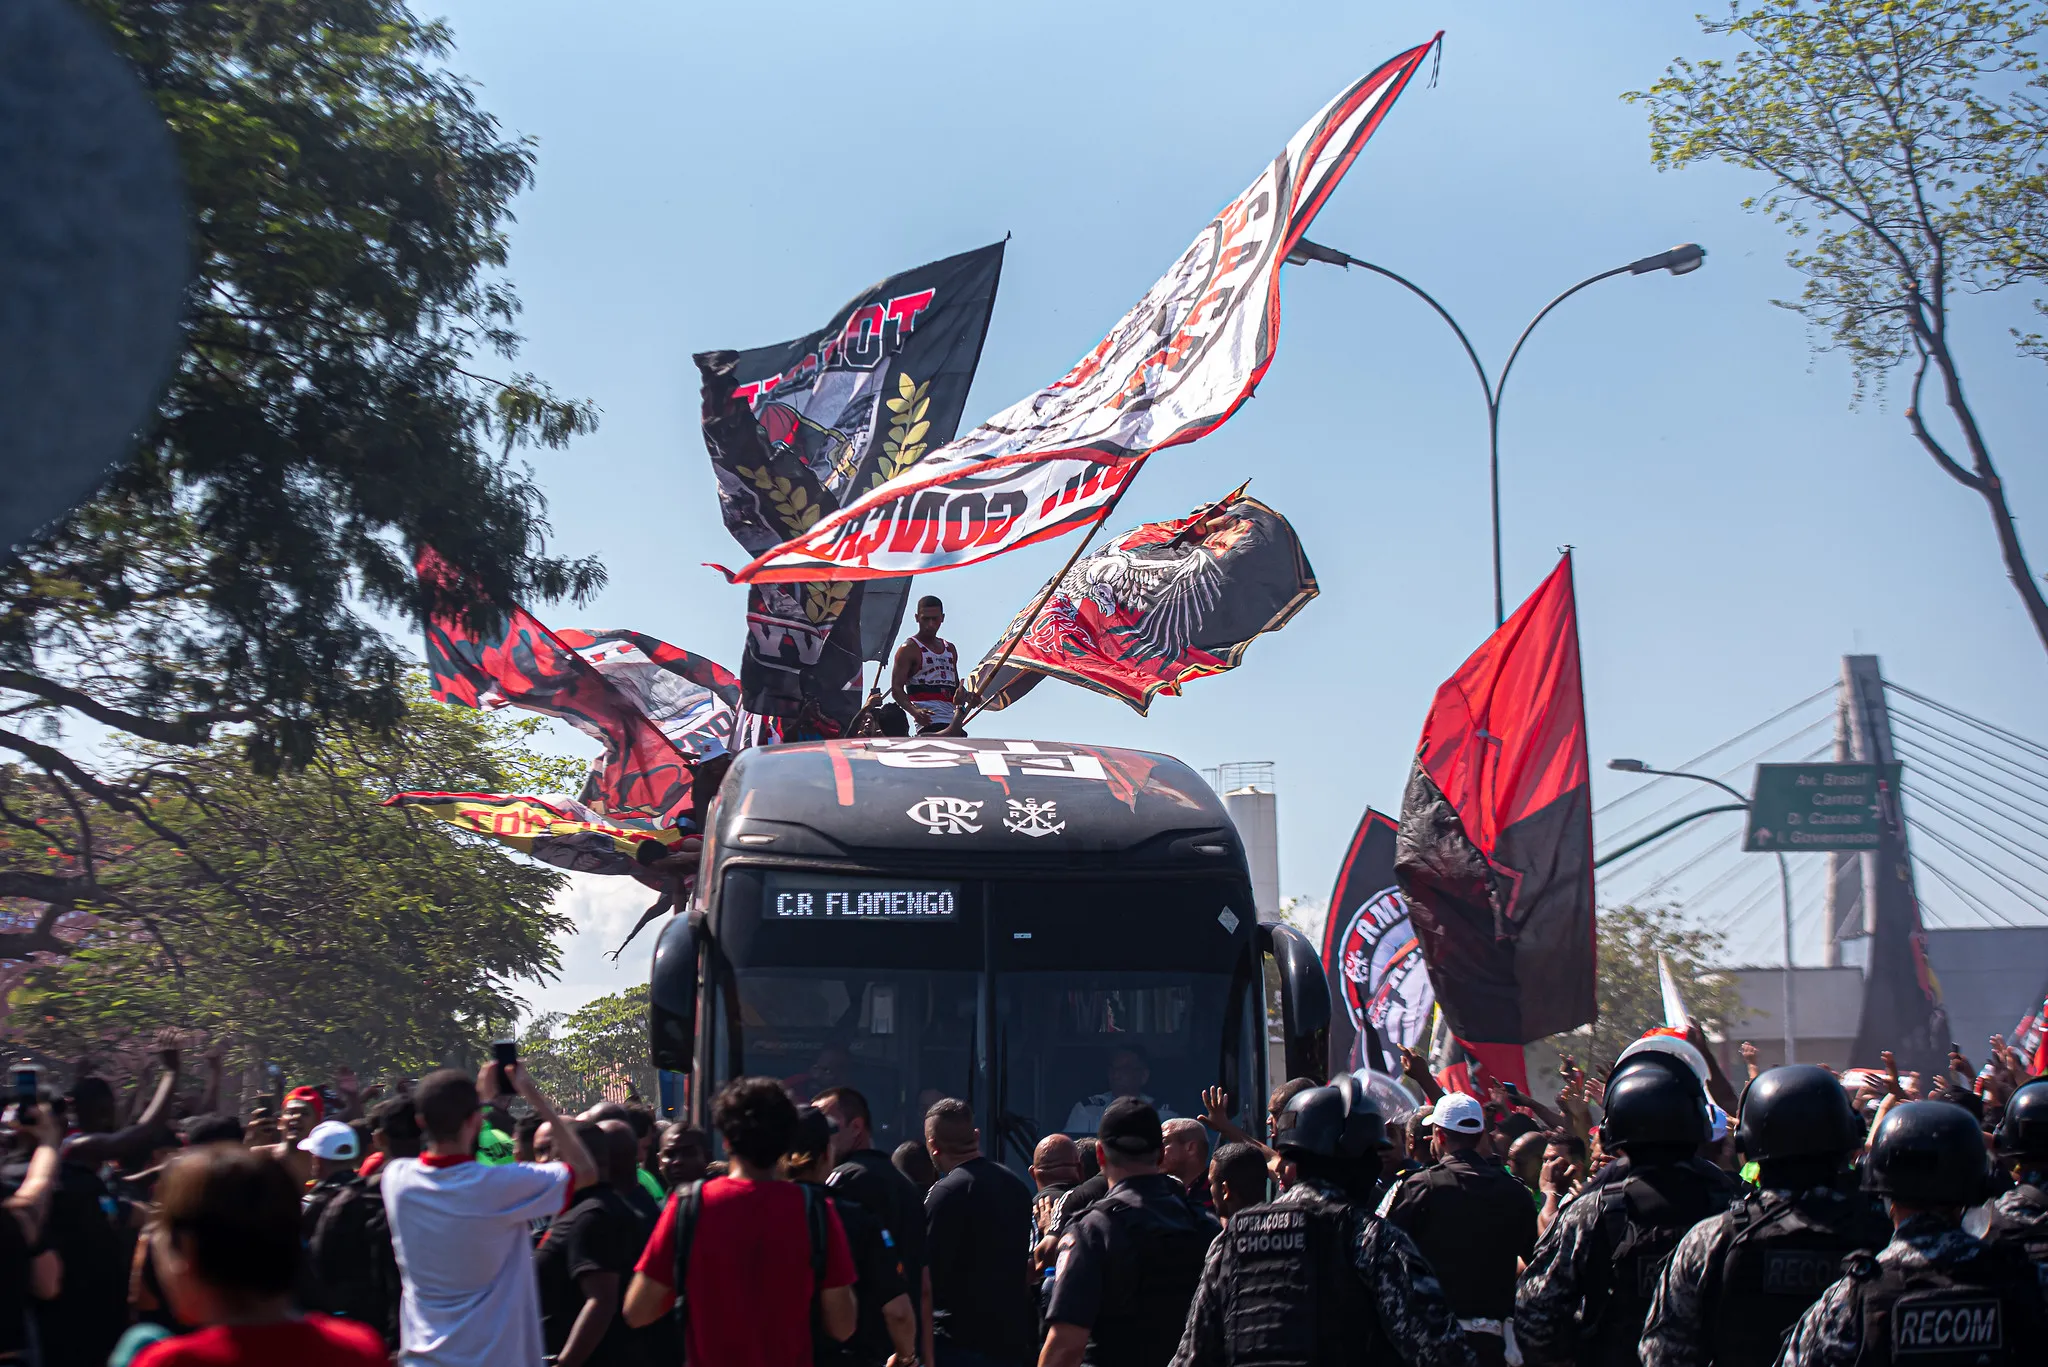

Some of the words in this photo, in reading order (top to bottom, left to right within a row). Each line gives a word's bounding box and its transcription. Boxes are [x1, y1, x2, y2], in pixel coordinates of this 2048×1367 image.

[1823, 772, 1867, 786] Brasil
[1812, 793, 1866, 806] Centro
[1809, 812, 1862, 825] Caxias
[777, 893, 813, 916] C.R
[826, 891, 954, 916] FLAMENGO
[1292, 1212, 1306, 1228] DE
[1236, 1233, 1305, 1253] CHOQUE
[1768, 1257, 1841, 1288] RECO
[1901, 1307, 1996, 1345] RECOM
